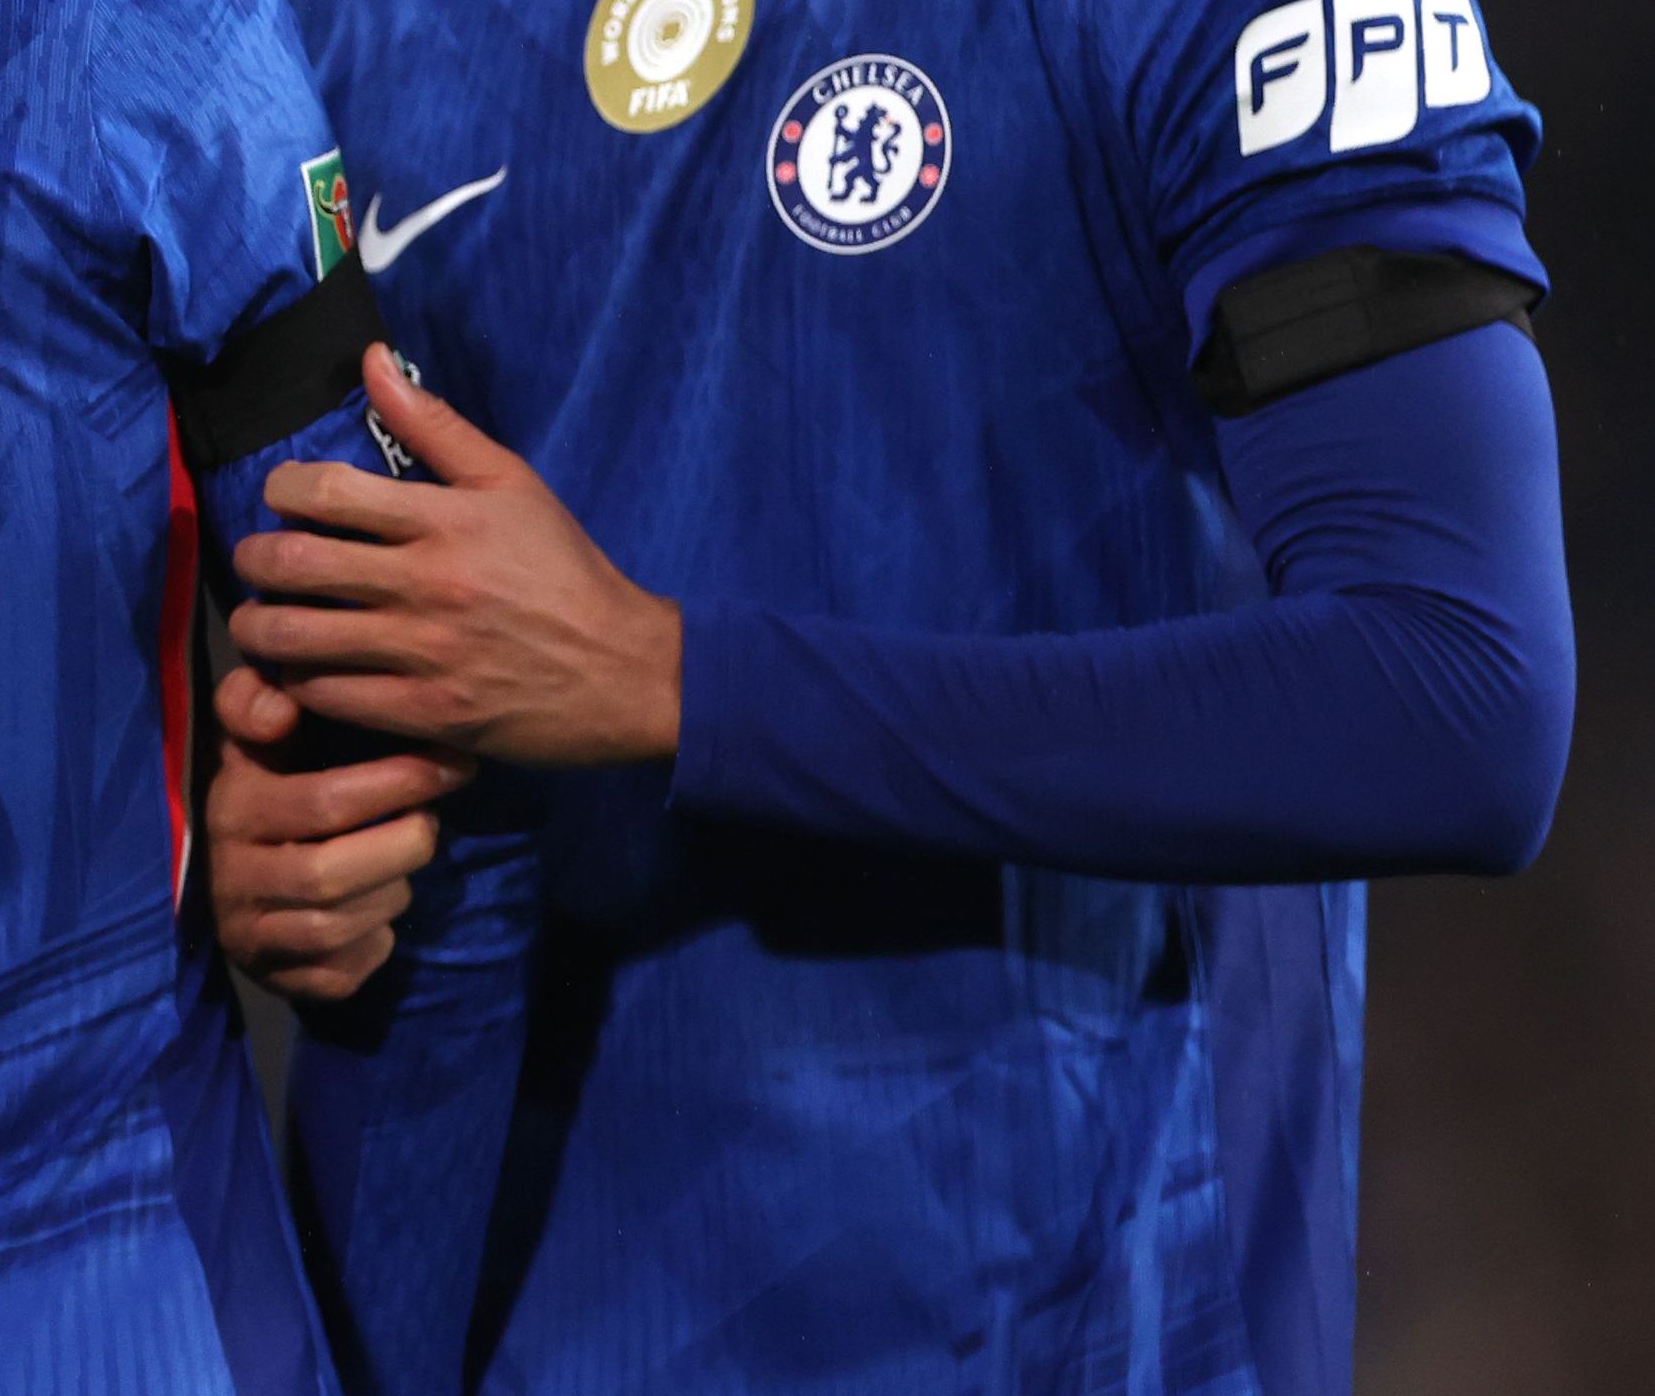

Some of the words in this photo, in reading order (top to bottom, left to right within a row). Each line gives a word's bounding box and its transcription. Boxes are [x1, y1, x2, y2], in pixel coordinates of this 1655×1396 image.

[812, 61, 925, 106] CHELSEA
[1248, 10, 1470, 117] FPT
[627, 80, 690, 117] FIFA
